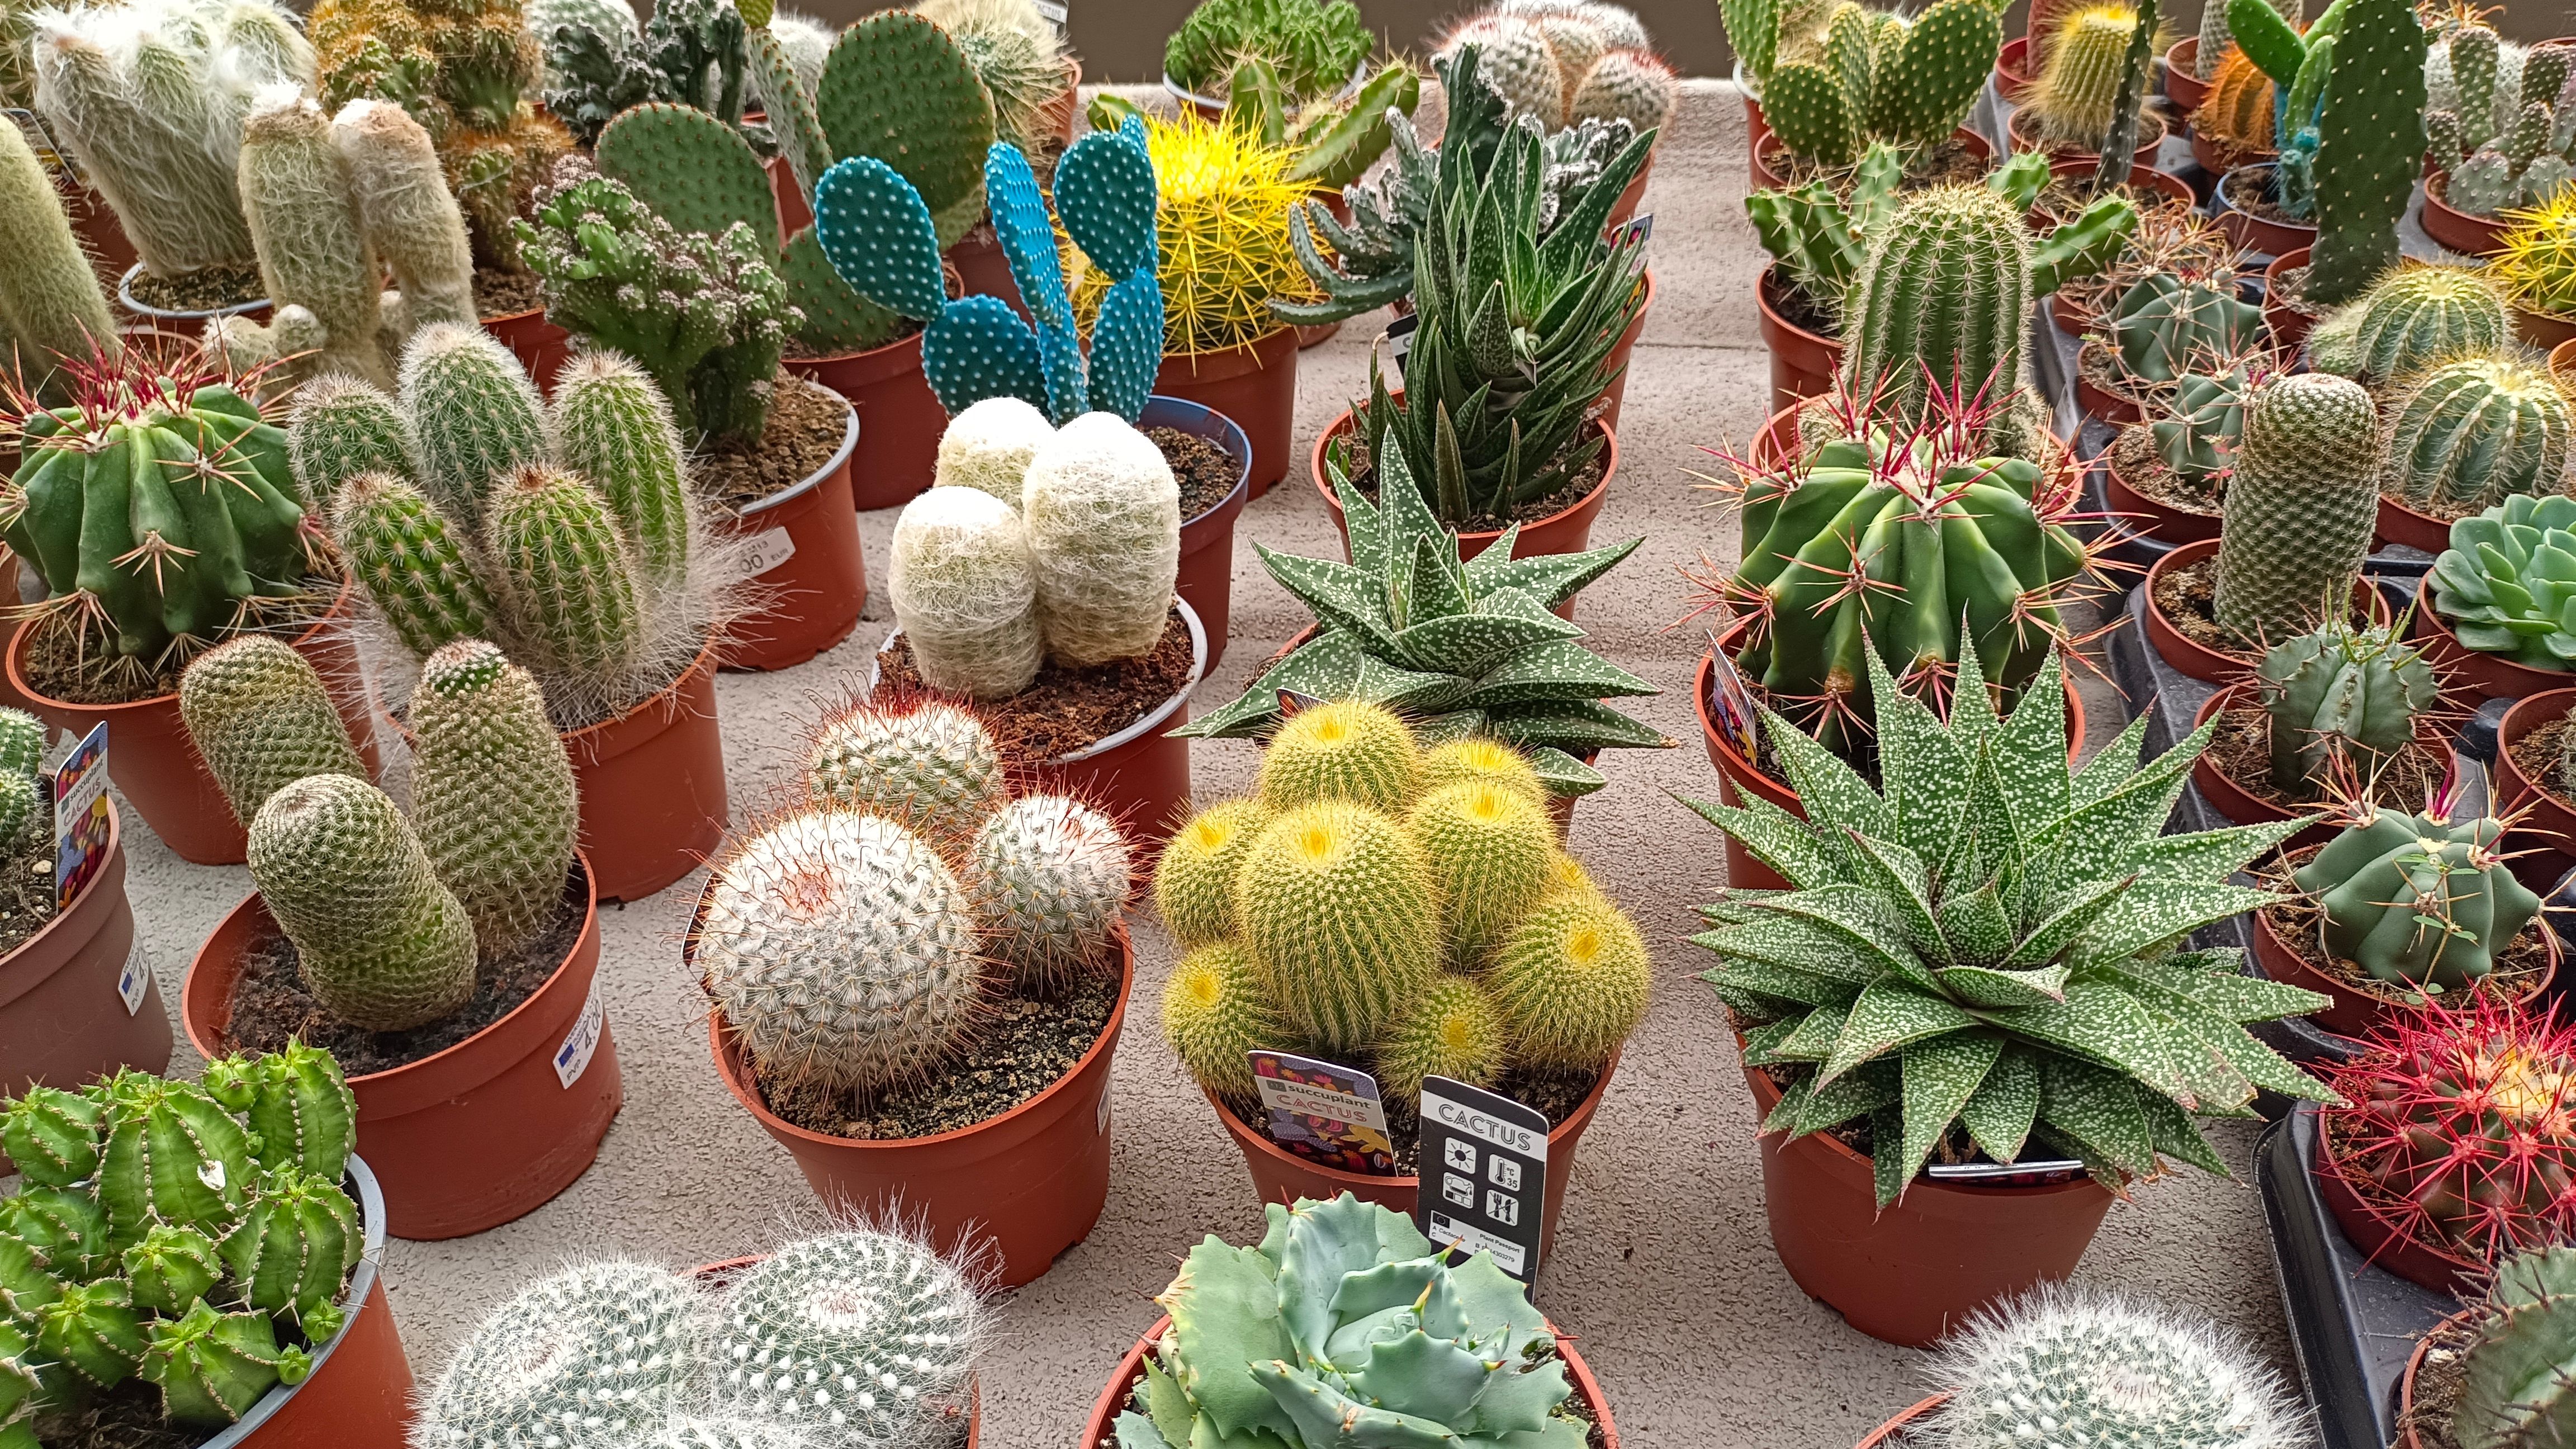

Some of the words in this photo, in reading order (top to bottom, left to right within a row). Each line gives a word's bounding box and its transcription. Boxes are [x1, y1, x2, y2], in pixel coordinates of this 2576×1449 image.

[771, 548, 789, 561] EUR
[70, 759, 103, 802] succuplant
[63, 776, 101, 827] CACTUS
[566, 1059, 581, 1081] PVP
[1276, 1094, 1367, 1122] CACTUS
[1288, 1085, 1371, 1109] succuplant
[1438, 1104, 1531, 1151] CACTUS
[1507, 1178, 1518, 1188] 35
[1479, 1233, 1495, 1243] Plant
[1495, 1239, 1520, 1253] Passport
